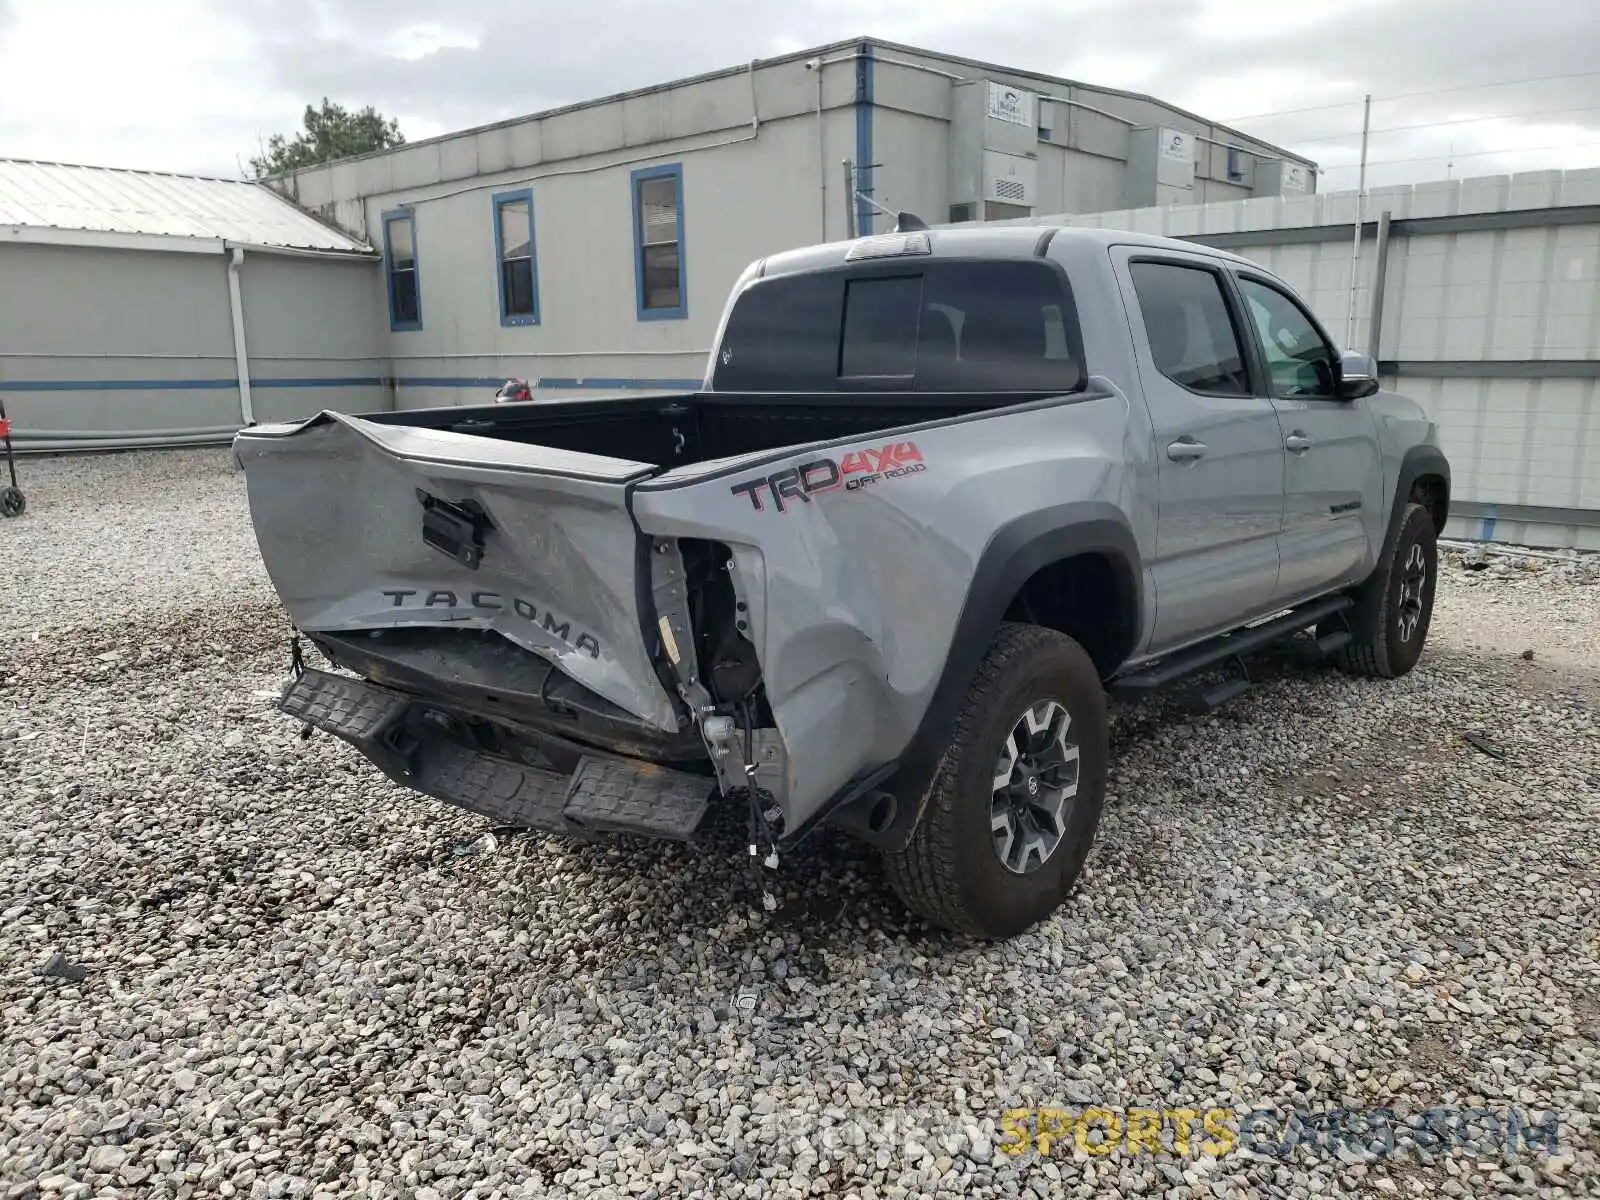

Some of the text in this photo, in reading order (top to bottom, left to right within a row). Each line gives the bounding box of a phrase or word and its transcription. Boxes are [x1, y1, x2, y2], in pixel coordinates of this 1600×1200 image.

[730, 458, 843, 514] TRD
[845, 462, 927, 491] OFF ROAD
[382, 590, 600, 660] TACOMA
